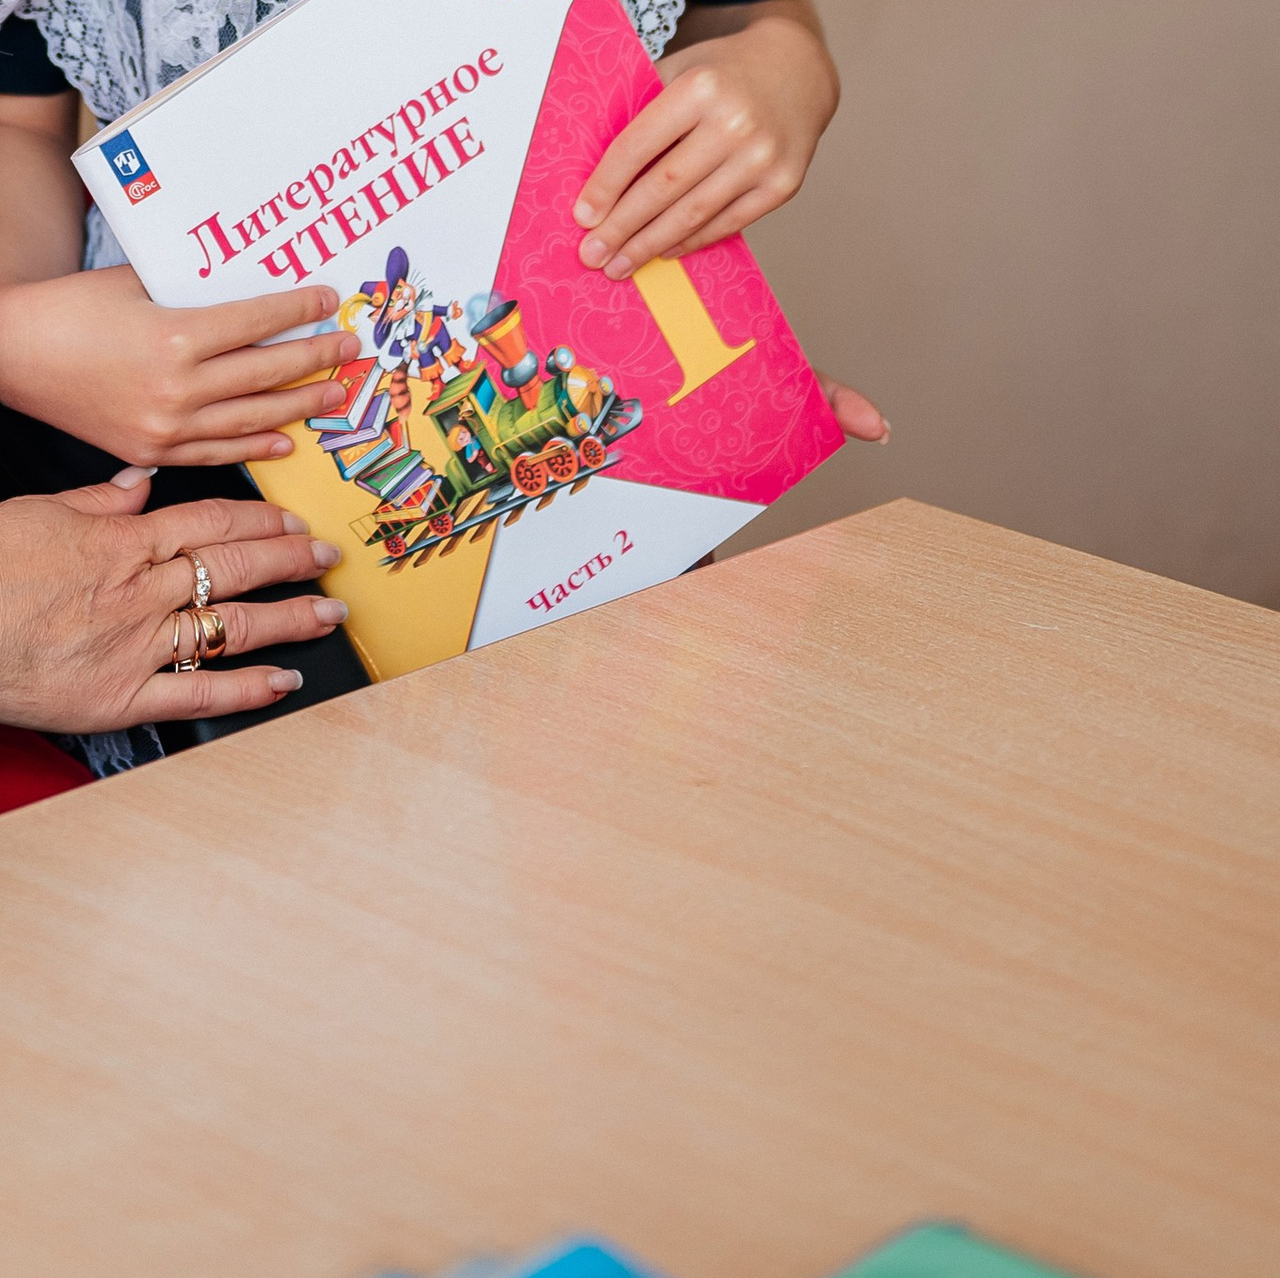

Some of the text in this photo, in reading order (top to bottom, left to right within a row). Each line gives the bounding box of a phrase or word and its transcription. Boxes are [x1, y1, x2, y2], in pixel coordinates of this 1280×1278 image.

[186, 47, 505, 279] Литературное
[256, 116, 486, 285] ЧТЕНИЕ
[524, 529, 635, 614] Часть 2
